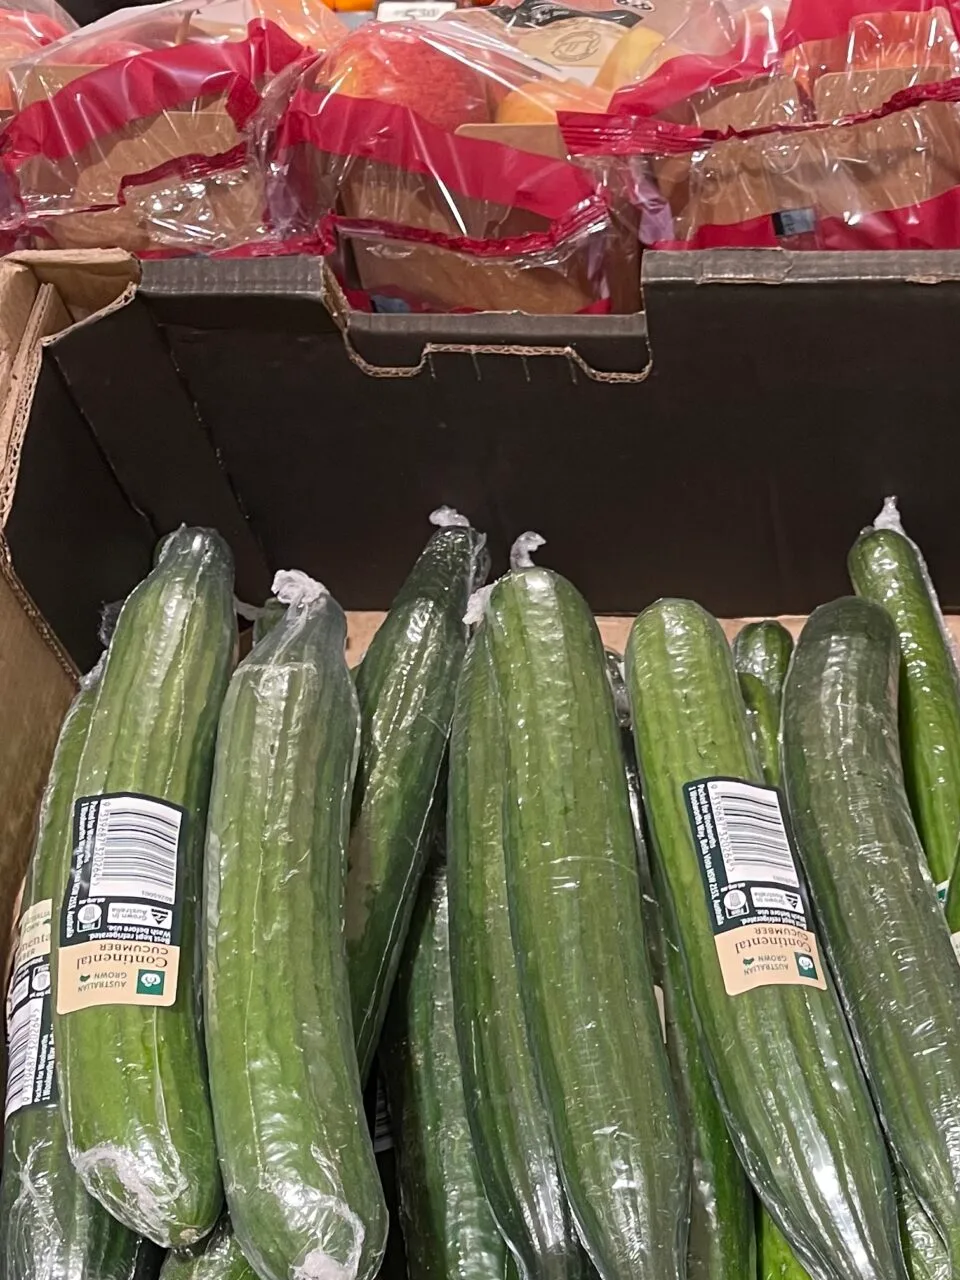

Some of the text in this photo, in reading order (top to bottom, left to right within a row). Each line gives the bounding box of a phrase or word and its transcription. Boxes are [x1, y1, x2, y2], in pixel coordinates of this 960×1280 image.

[690, 790, 702, 825] Woolworths
[697, 784, 708, 805] Packed
[704, 813, 716, 848] Woolworths
[700, 839, 709, 855] Bella
[704, 854, 712, 869] Vista
[707, 868, 716, 883] NSW
[713, 899, 724, 925] Australia
[124, 926, 150, 934] before
[150, 929, 171, 938] Wash
[755, 927, 808, 941] CUCUMBER
[136, 934, 152, 942] kept
[735, 936, 812, 954] Continental
[99, 943, 168, 955] CUCUMBER
[77, 953, 168, 970] Continental
[744, 963, 788, 975] AUSTRALIAN
[94, 971, 127, 979] GROWN
[78, 980, 127, 992] AUSTRALIAN
[42, 1059, 55, 1097] Woolworths
[34, 1080, 43, 1103] Packed
